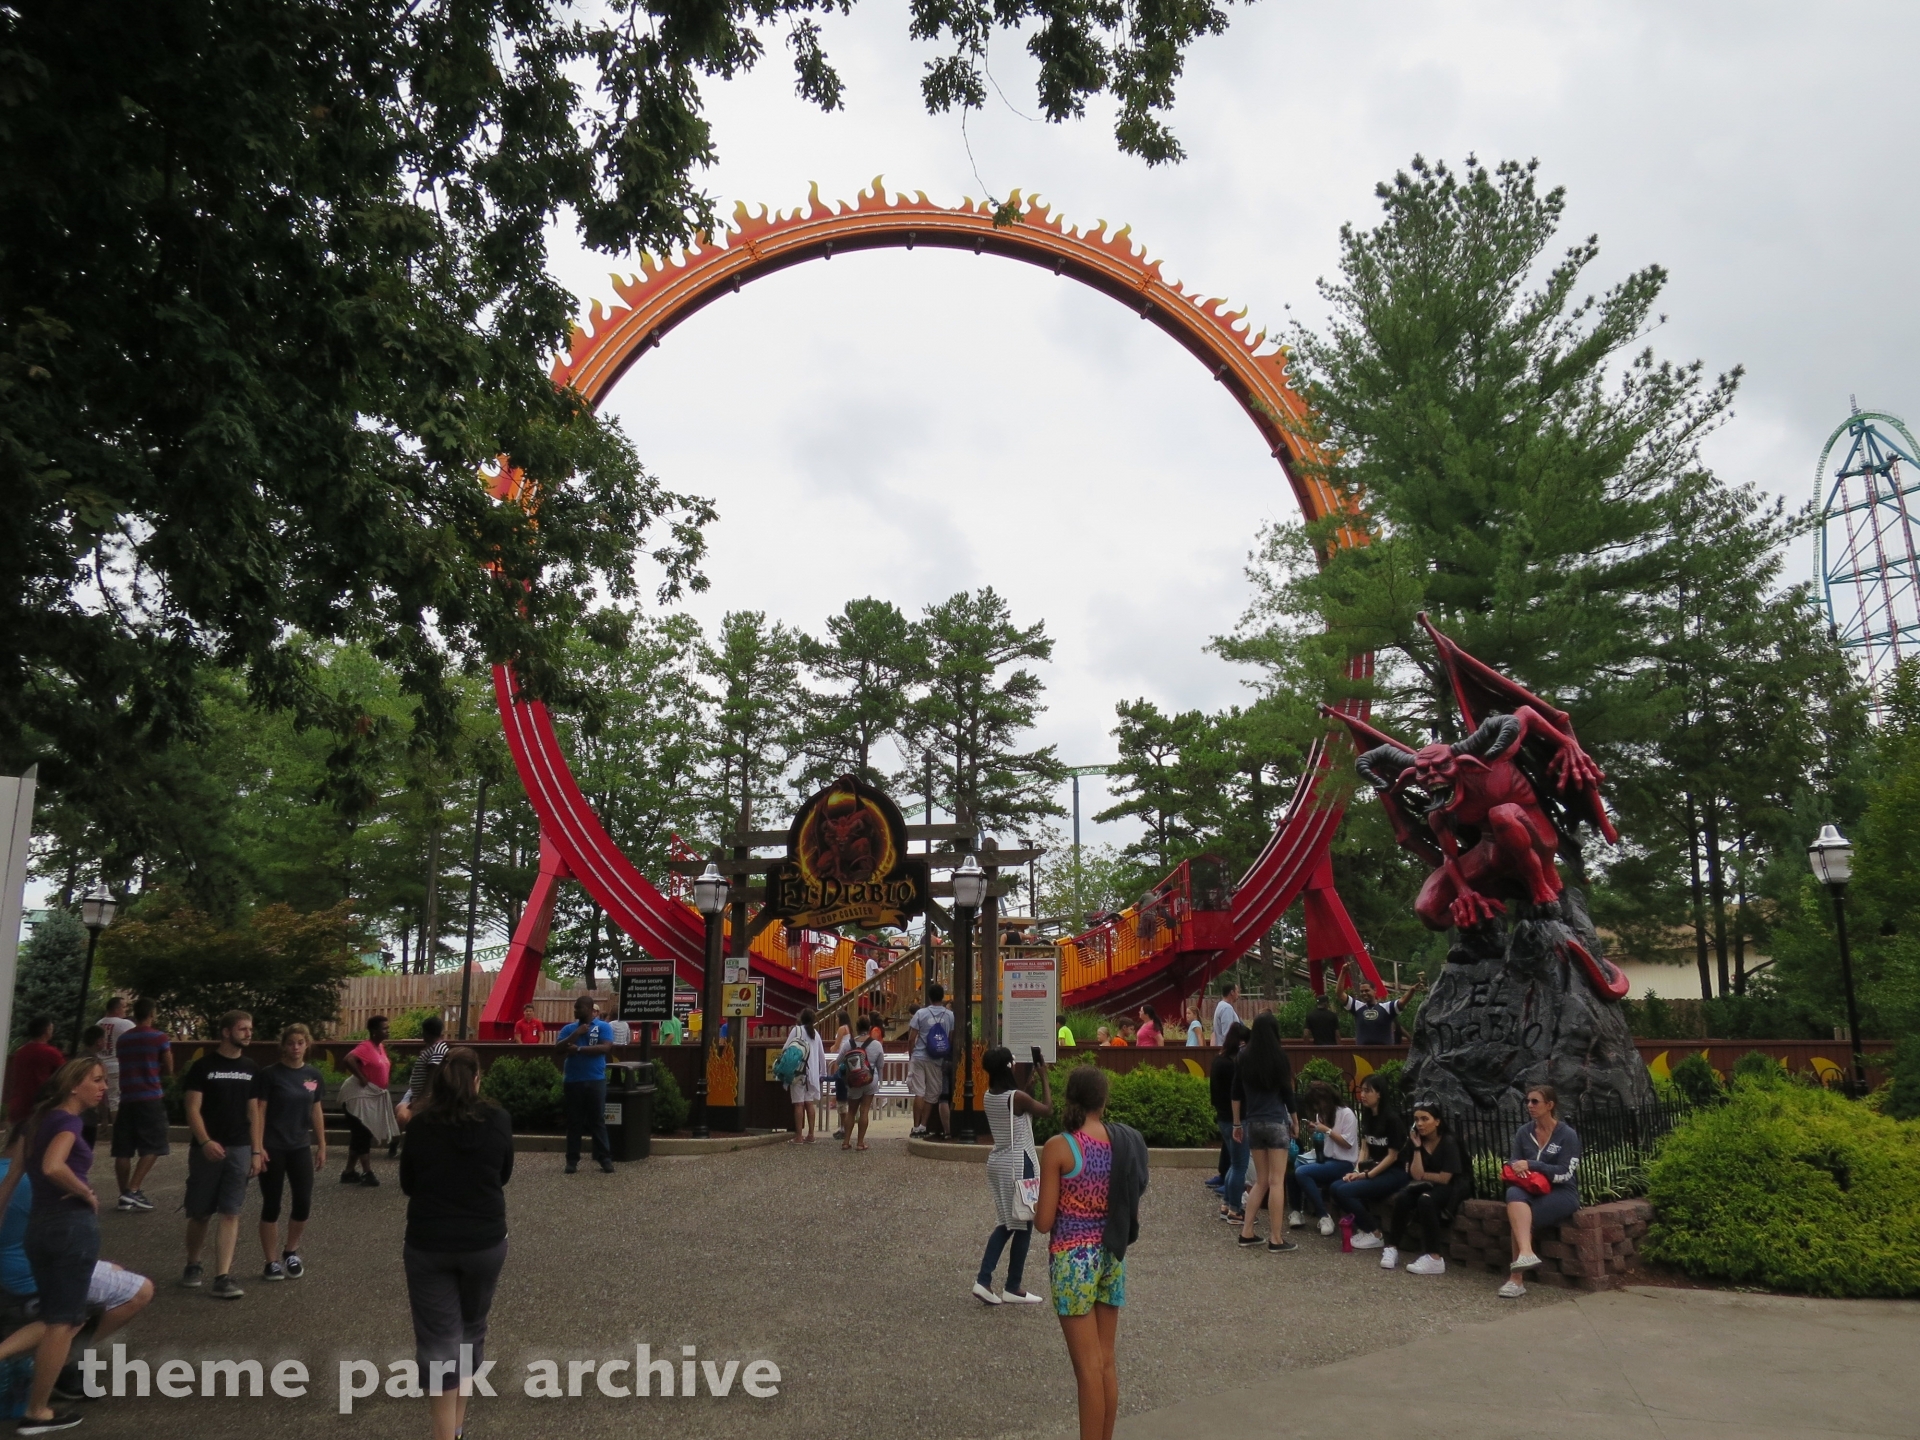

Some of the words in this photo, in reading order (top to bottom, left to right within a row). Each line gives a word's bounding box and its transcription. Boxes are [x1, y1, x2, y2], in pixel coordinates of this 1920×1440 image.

[816, 913, 838, 925] LOOP
[839, 906, 874, 920] COASTER
[1467, 978, 1508, 1008] EL
